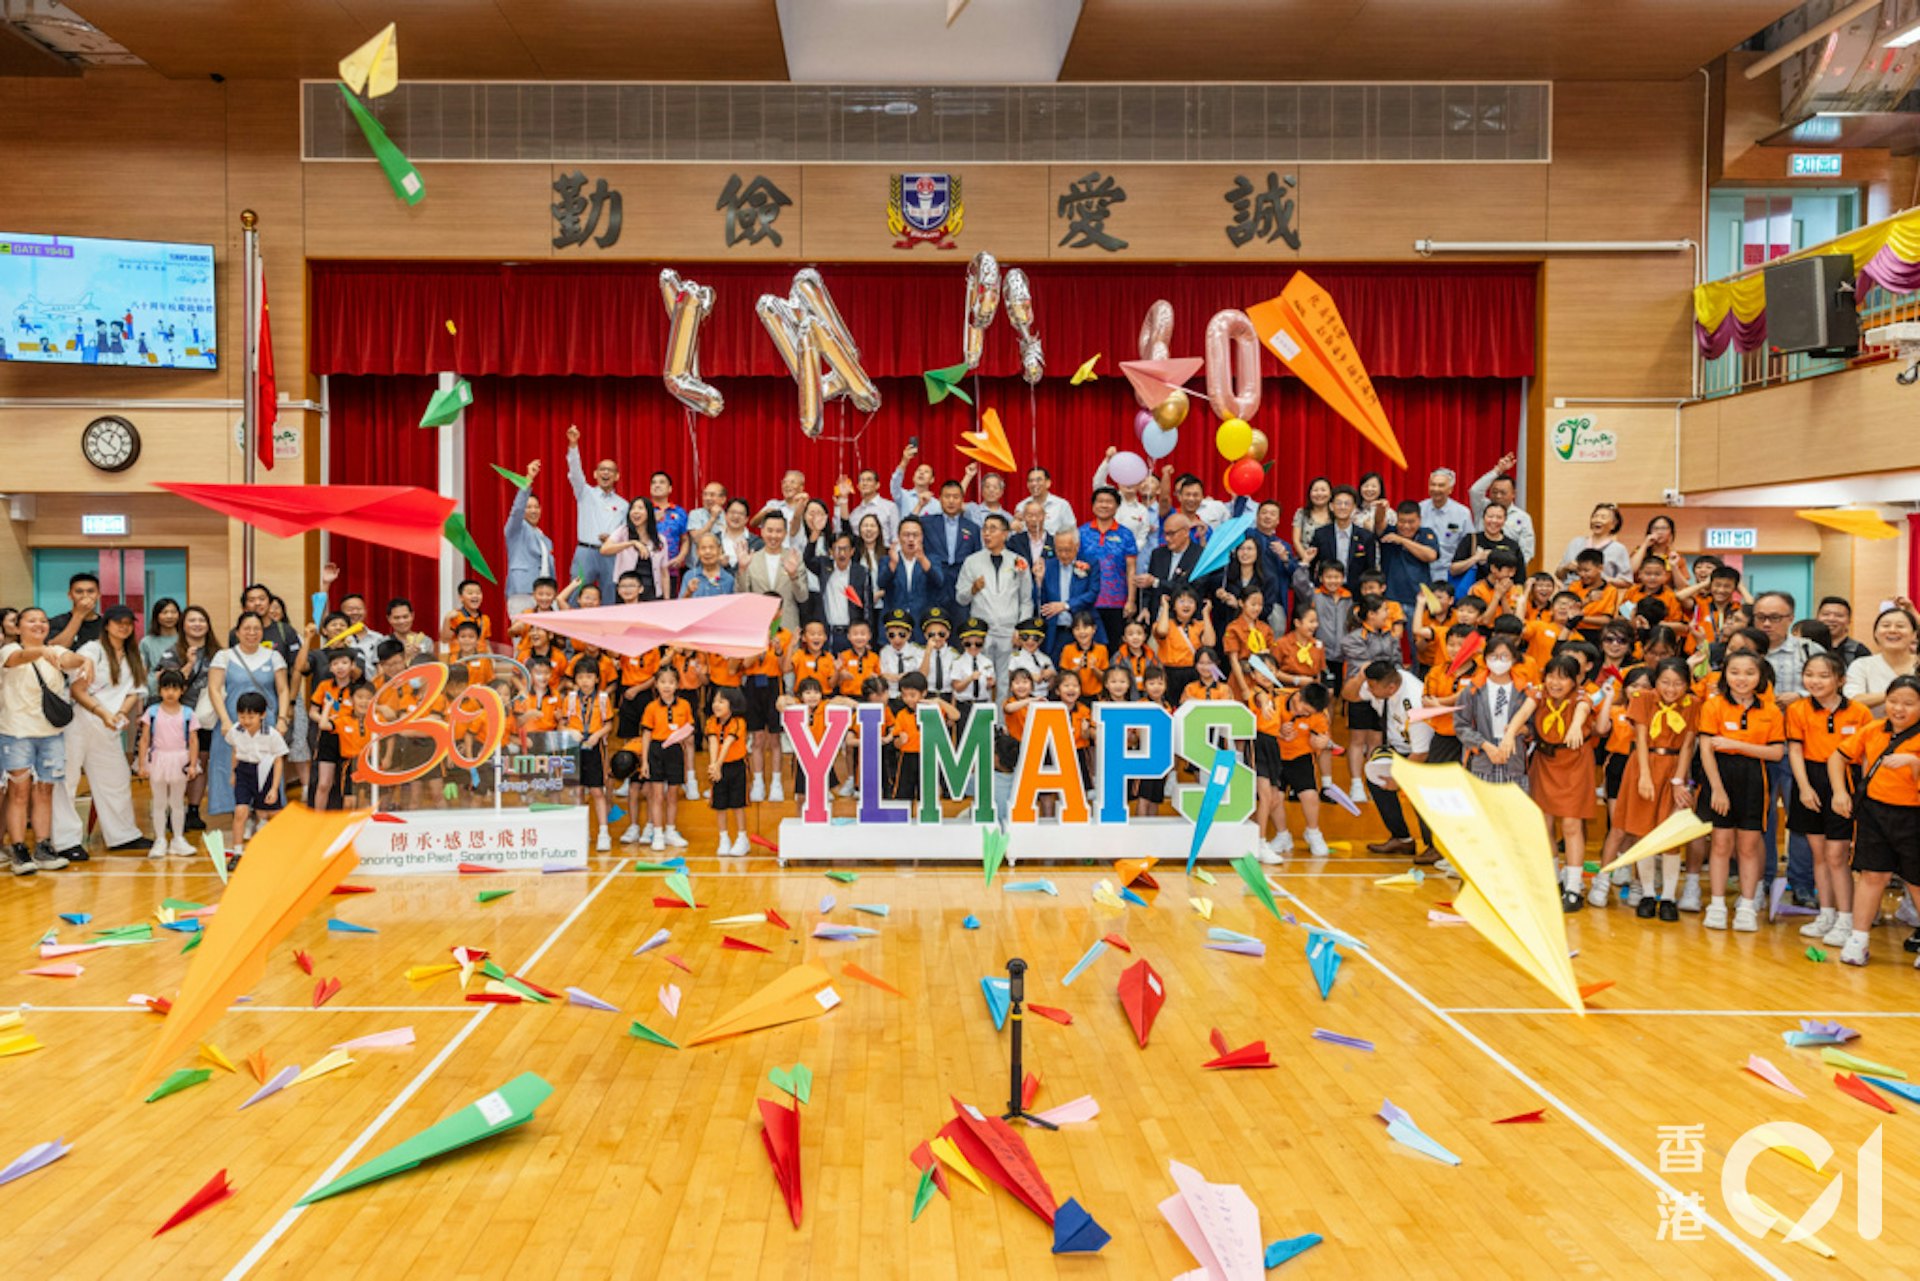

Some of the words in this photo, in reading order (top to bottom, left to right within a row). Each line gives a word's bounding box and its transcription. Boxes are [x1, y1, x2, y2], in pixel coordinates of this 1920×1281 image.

[1794, 155, 1818, 173] EXIT
[14, 244, 41, 255] GATE
[782, 701, 1258, 824] YLMAPS
[360, 854, 404, 867] onoring
[406, 853, 425, 863] the
[427, 852, 453, 863] Past
[460, 850, 504, 864] Soaring
[505, 849, 519, 860] to
[520, 848, 540, 859] the
[541, 847, 578, 858] Future
